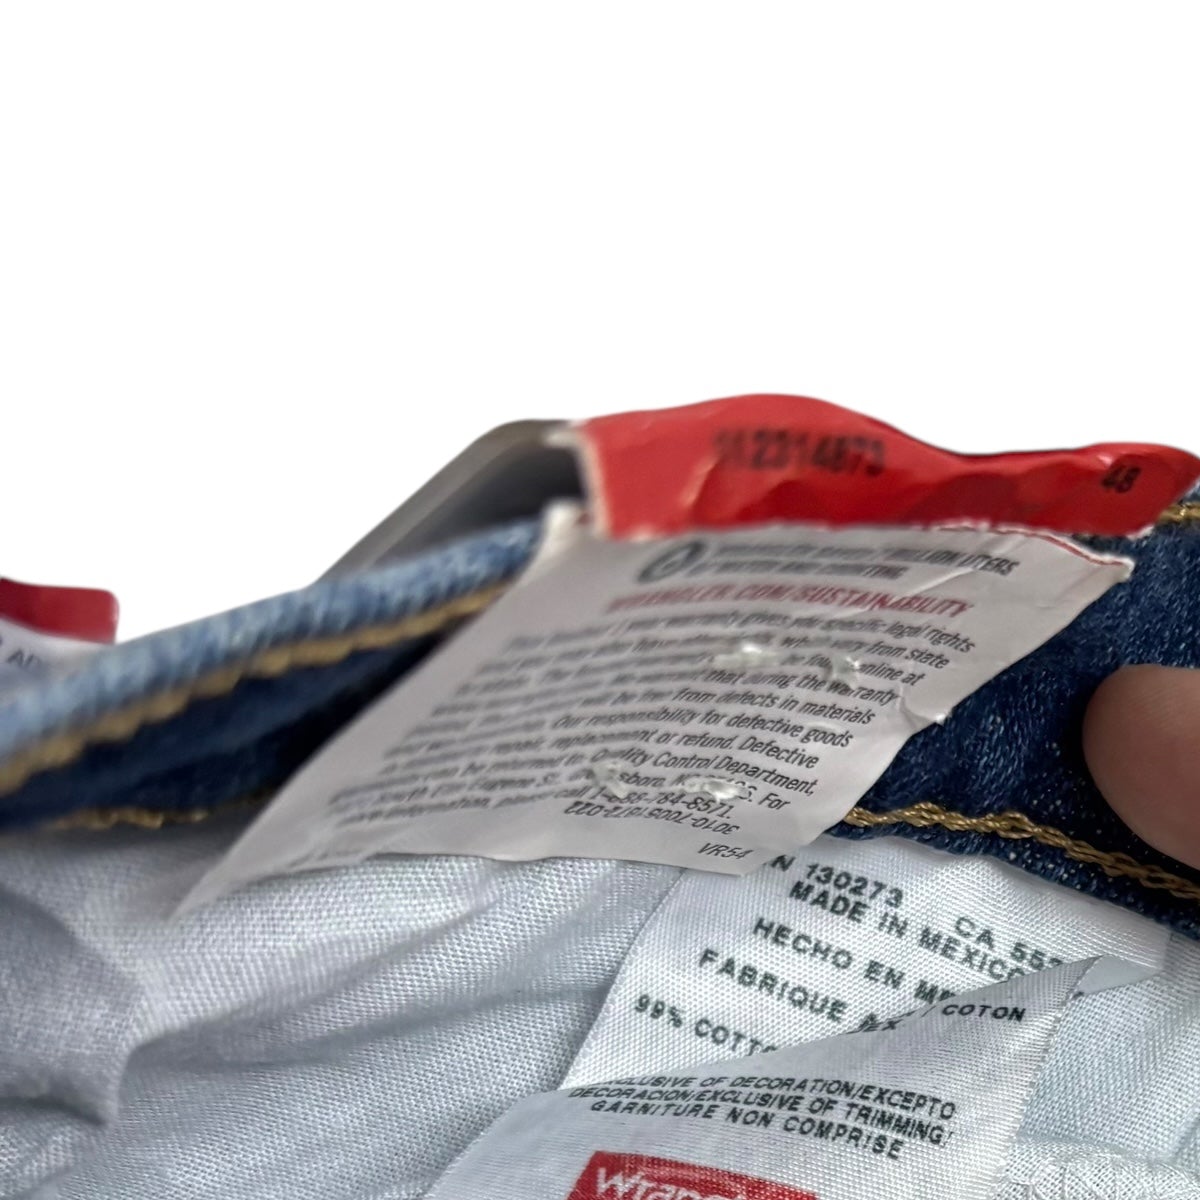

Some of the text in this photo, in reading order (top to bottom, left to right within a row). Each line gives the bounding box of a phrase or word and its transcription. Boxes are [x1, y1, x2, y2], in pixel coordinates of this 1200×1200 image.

[865, 640, 907, 657] from
[904, 648, 951, 670] state
[885, 621, 928, 640] legal
[925, 627, 977, 653] rights
[704, 669, 744, 686] that
[800, 674, 828, 692] the
[901, 671, 927, 687] at
[672, 687, 717, 703] from
[716, 688, 781, 711] defects
[780, 694, 801, 713] in
[797, 697, 877, 726] materials
[701, 710, 726, 726] for
[728, 711, 804, 738] defective
[803, 725, 855, 749] goods
[655, 732, 679, 745] or
[678, 731, 735, 751] refund.
[737, 737, 821, 770] Defective
[652, 751, 718, 769] Control
[715, 755, 816, 796] Department,
[759, 792, 792, 811] For
[698, 842, 753, 859] VR54
[789, 881, 870, 924] MADE
[877, 911, 909, 938] IN
[806, 863, 904, 908] 130273
[954, 916, 995, 949] CA
[753, 917, 906, 990] HECHO EN
[699, 947, 848, 1024] FABRIQUE
[634, 994, 684, 1029] 99%
[568, 1087, 801, 1113] DECORACION/EXCLUSIVE
[807, 1097, 836, 1115] OF
[699, 1077, 728, 1088] OF
[729, 1076, 957, 1121] DECORATION/EXCEPTO
[590, 1099, 905, 1161] GARNITURE NON COMPRISE
